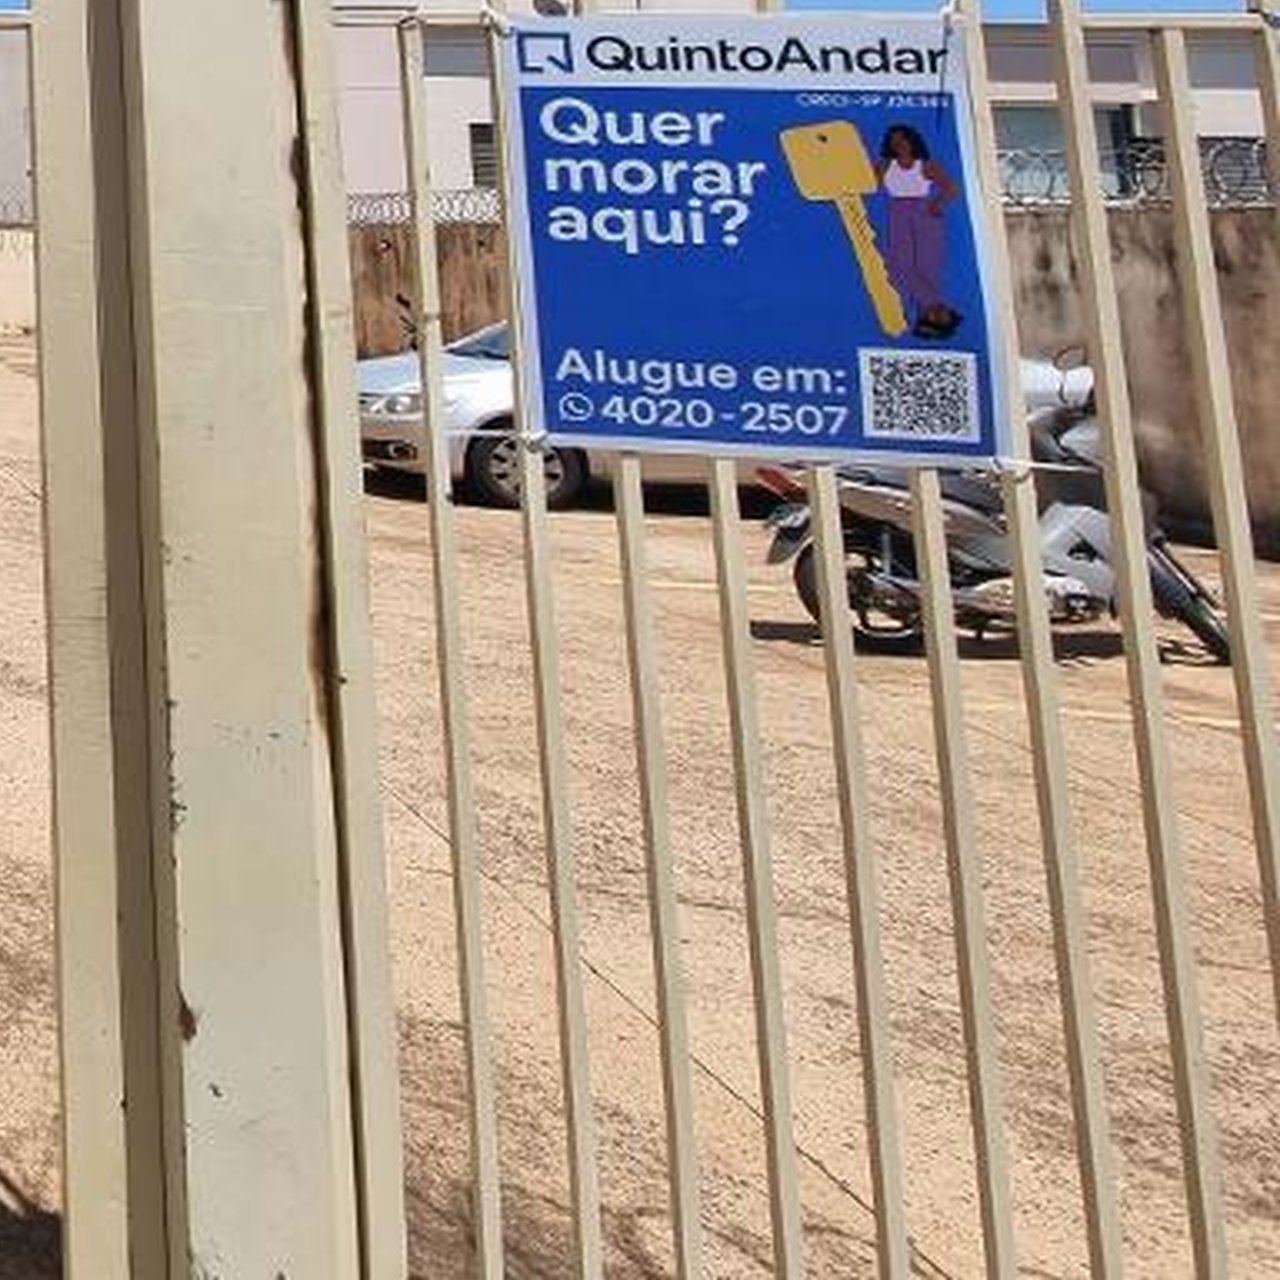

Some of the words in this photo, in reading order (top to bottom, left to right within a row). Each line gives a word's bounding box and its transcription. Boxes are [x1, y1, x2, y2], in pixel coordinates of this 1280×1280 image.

[586, 35, 947, 74] QuintoAndar
[540, 97, 725, 146] Quer
[545, 158, 766, 196] morar
[548, 198, 749, 254] aqui?
[555, 348, 738, 394] Alugue
[752, 365, 847, 394] em:
[601, 396, 848, 435] 4020-2507
